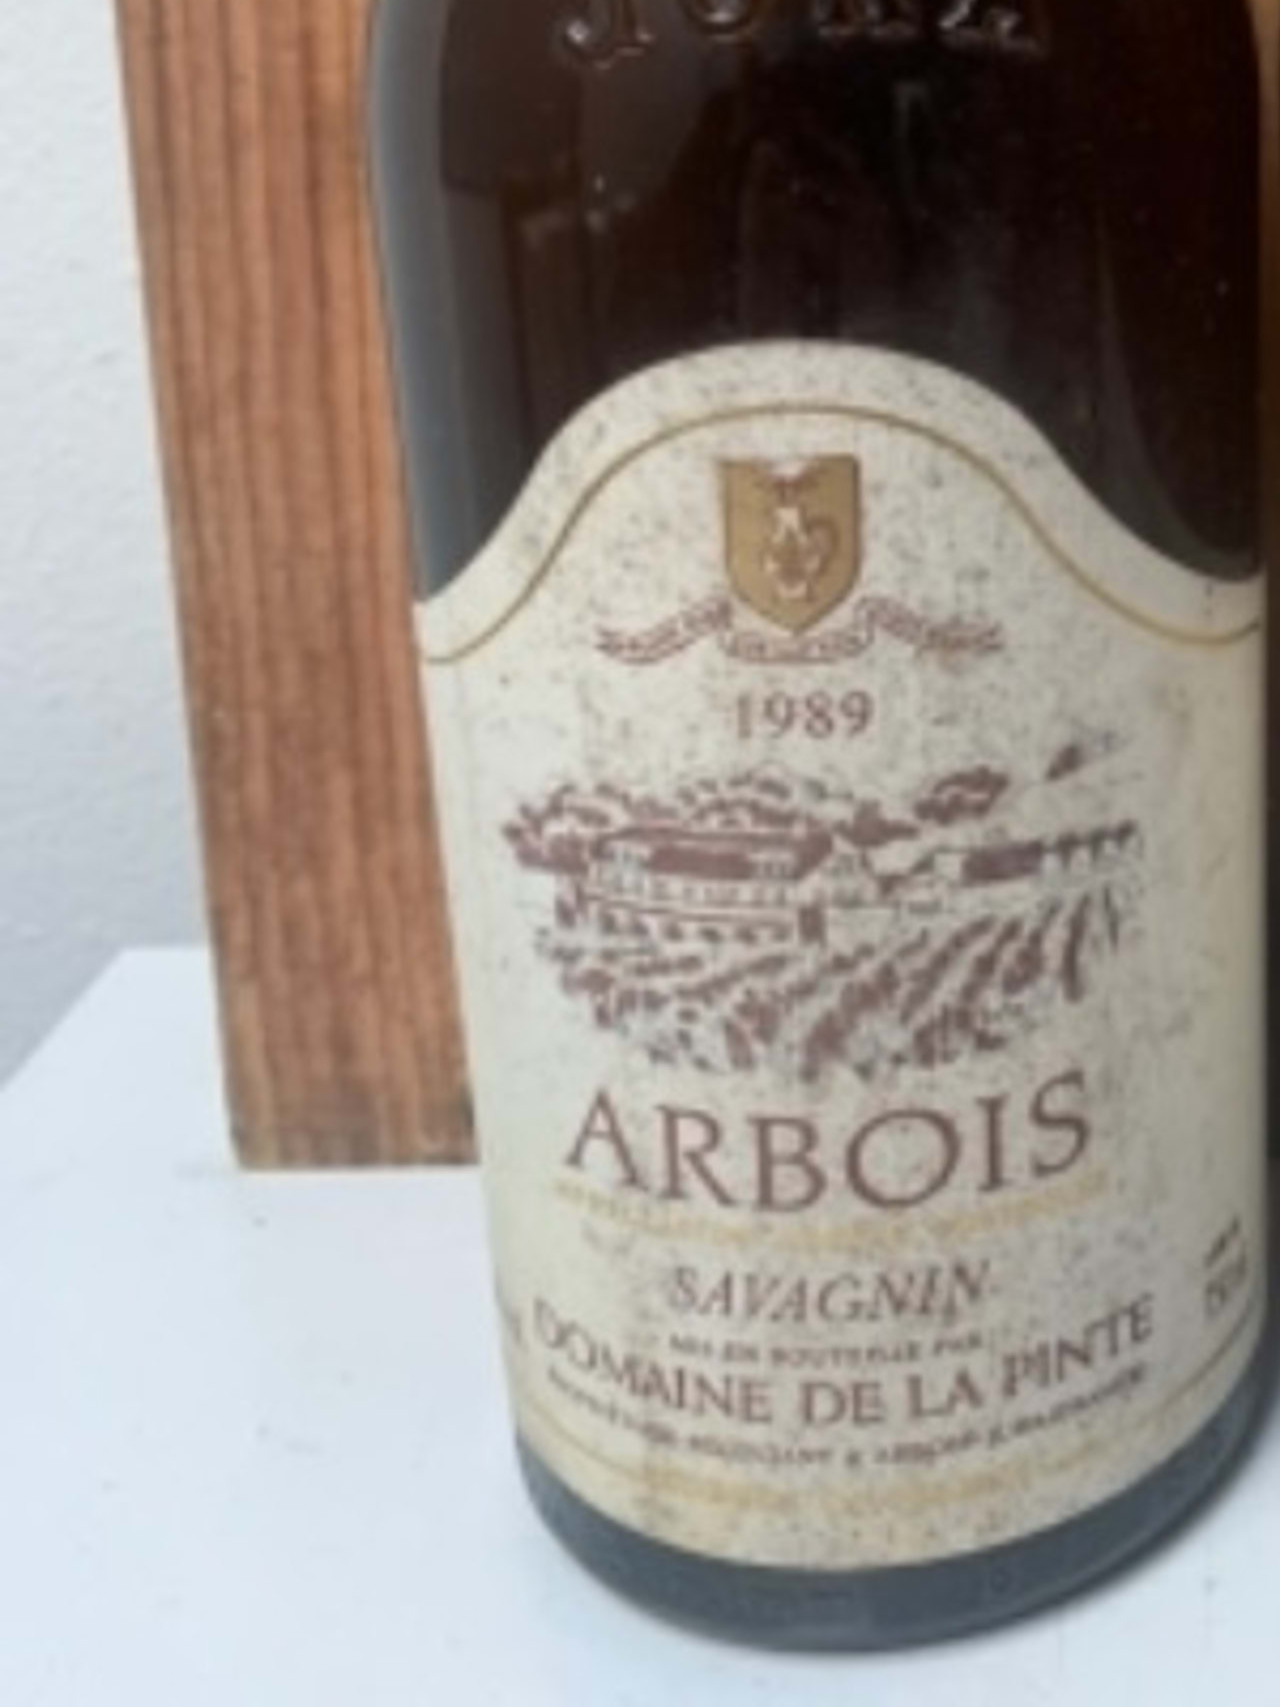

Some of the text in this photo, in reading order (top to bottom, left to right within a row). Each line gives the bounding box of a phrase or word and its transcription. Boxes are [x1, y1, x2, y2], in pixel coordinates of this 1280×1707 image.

[736, 690, 874, 739] 1989
[565, 1070, 1092, 1213] ARBOIS
[670, 1258, 993, 1325] SAVAGNIN
[533, 1296, 773, 1425] DOMAINE
[801, 1379, 886, 1426] DE
[906, 1373, 984, 1419] LA
[1001, 1292, 1156, 1399] PINTE
